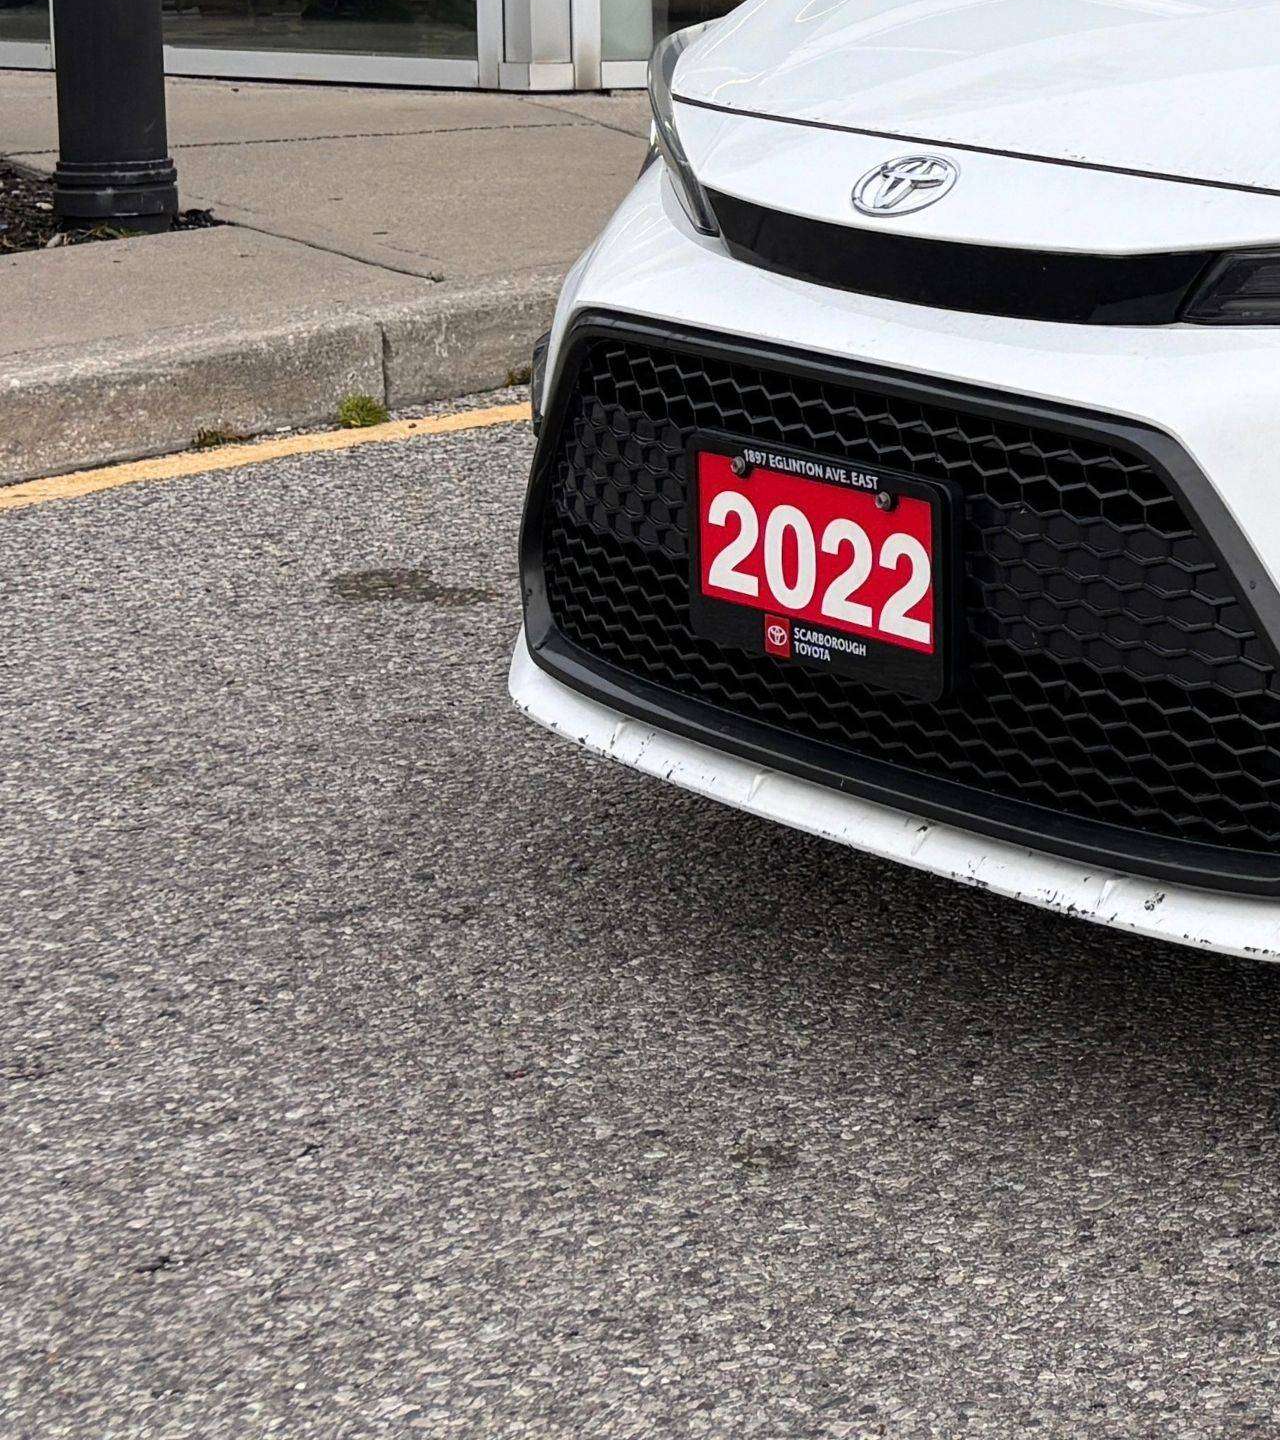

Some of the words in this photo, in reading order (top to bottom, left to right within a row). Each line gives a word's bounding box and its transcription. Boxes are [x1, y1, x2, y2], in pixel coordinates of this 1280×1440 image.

[744, 449, 766, 465] 1897
[769, 454, 823, 478] EGLINTON
[825, 466, 850, 483] AVE.
[852, 471, 879, 490] EAST
[708, 490, 931, 645] 2022
[793, 627, 867, 656] SCARBOROUGH
[794, 641, 830, 661] TOYOTA
